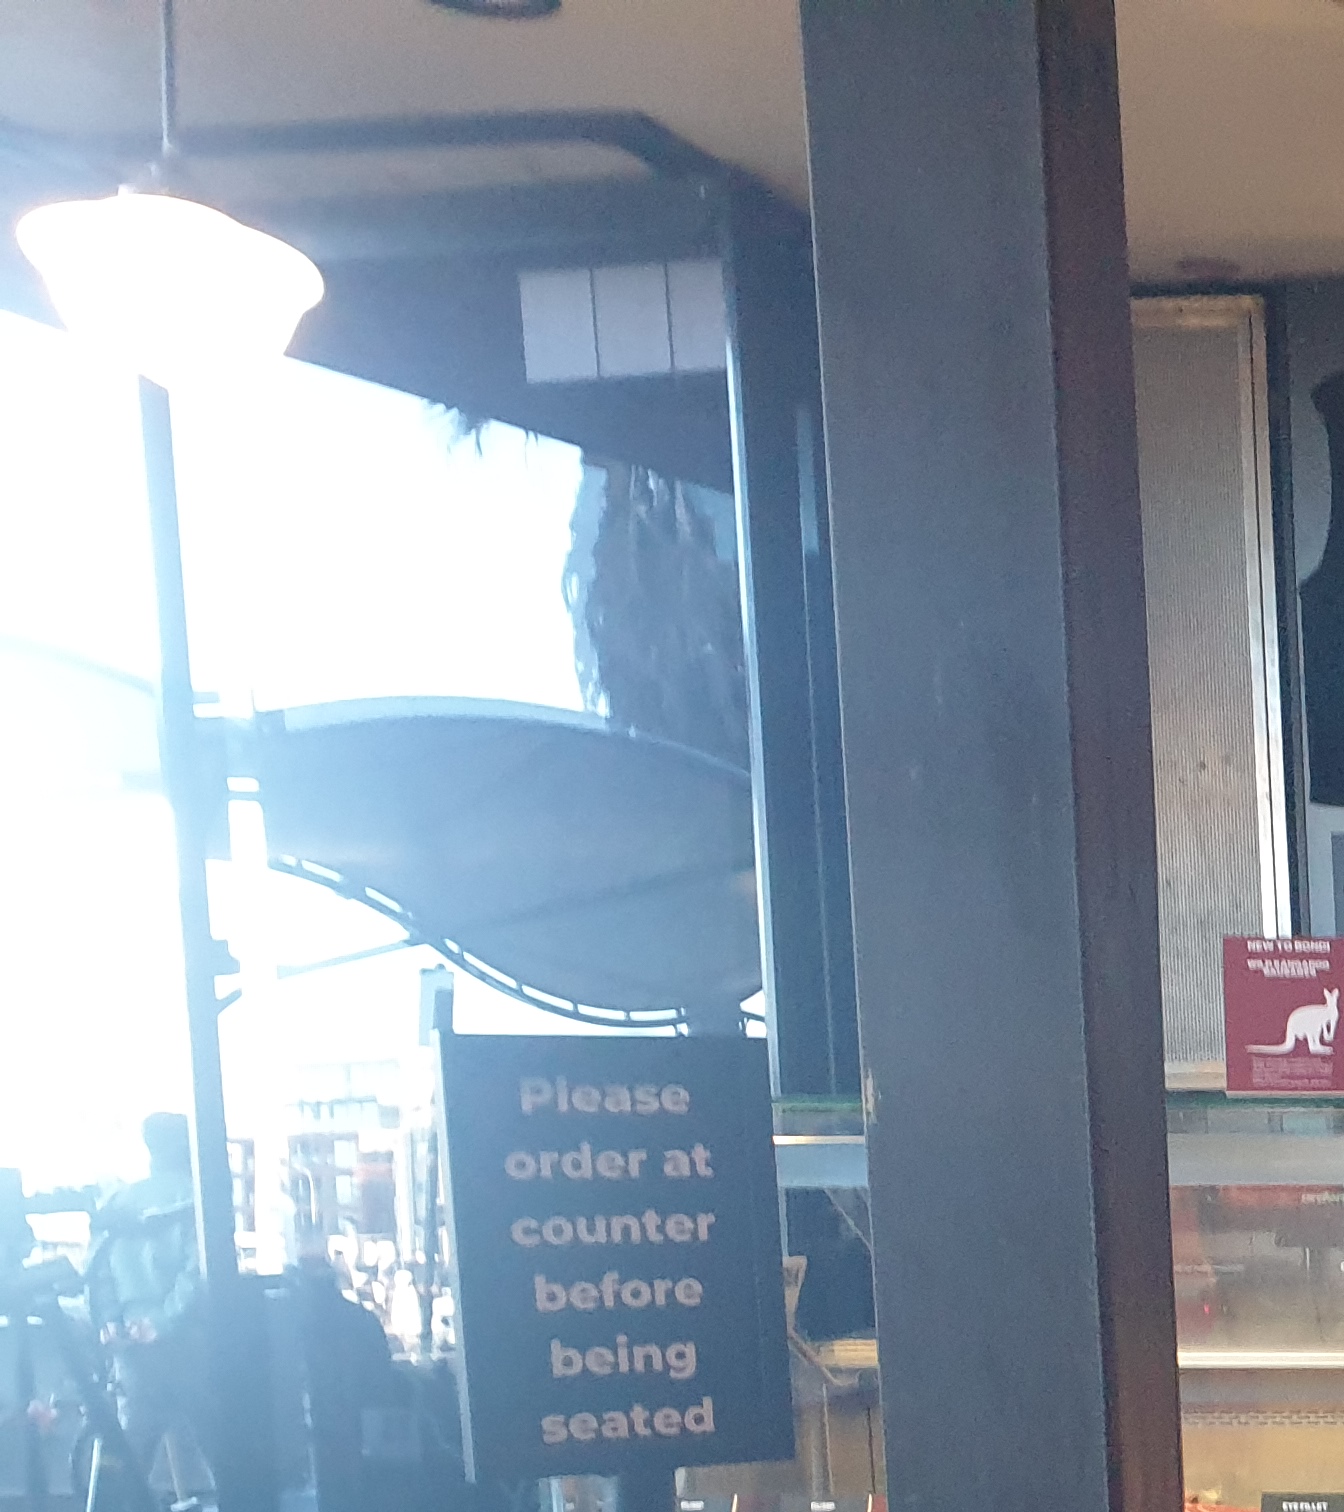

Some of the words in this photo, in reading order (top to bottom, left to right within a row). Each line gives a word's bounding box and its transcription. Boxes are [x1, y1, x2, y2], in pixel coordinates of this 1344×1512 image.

[519, 1075, 690, 1116] Please
[504, 1141, 647, 1181] order
[662, 1142, 715, 1180] at
[510, 1208, 716, 1248] counter
[534, 1271, 703, 1314] before
[550, 1333, 698, 1380] being
[541, 1395, 716, 1446] seated
